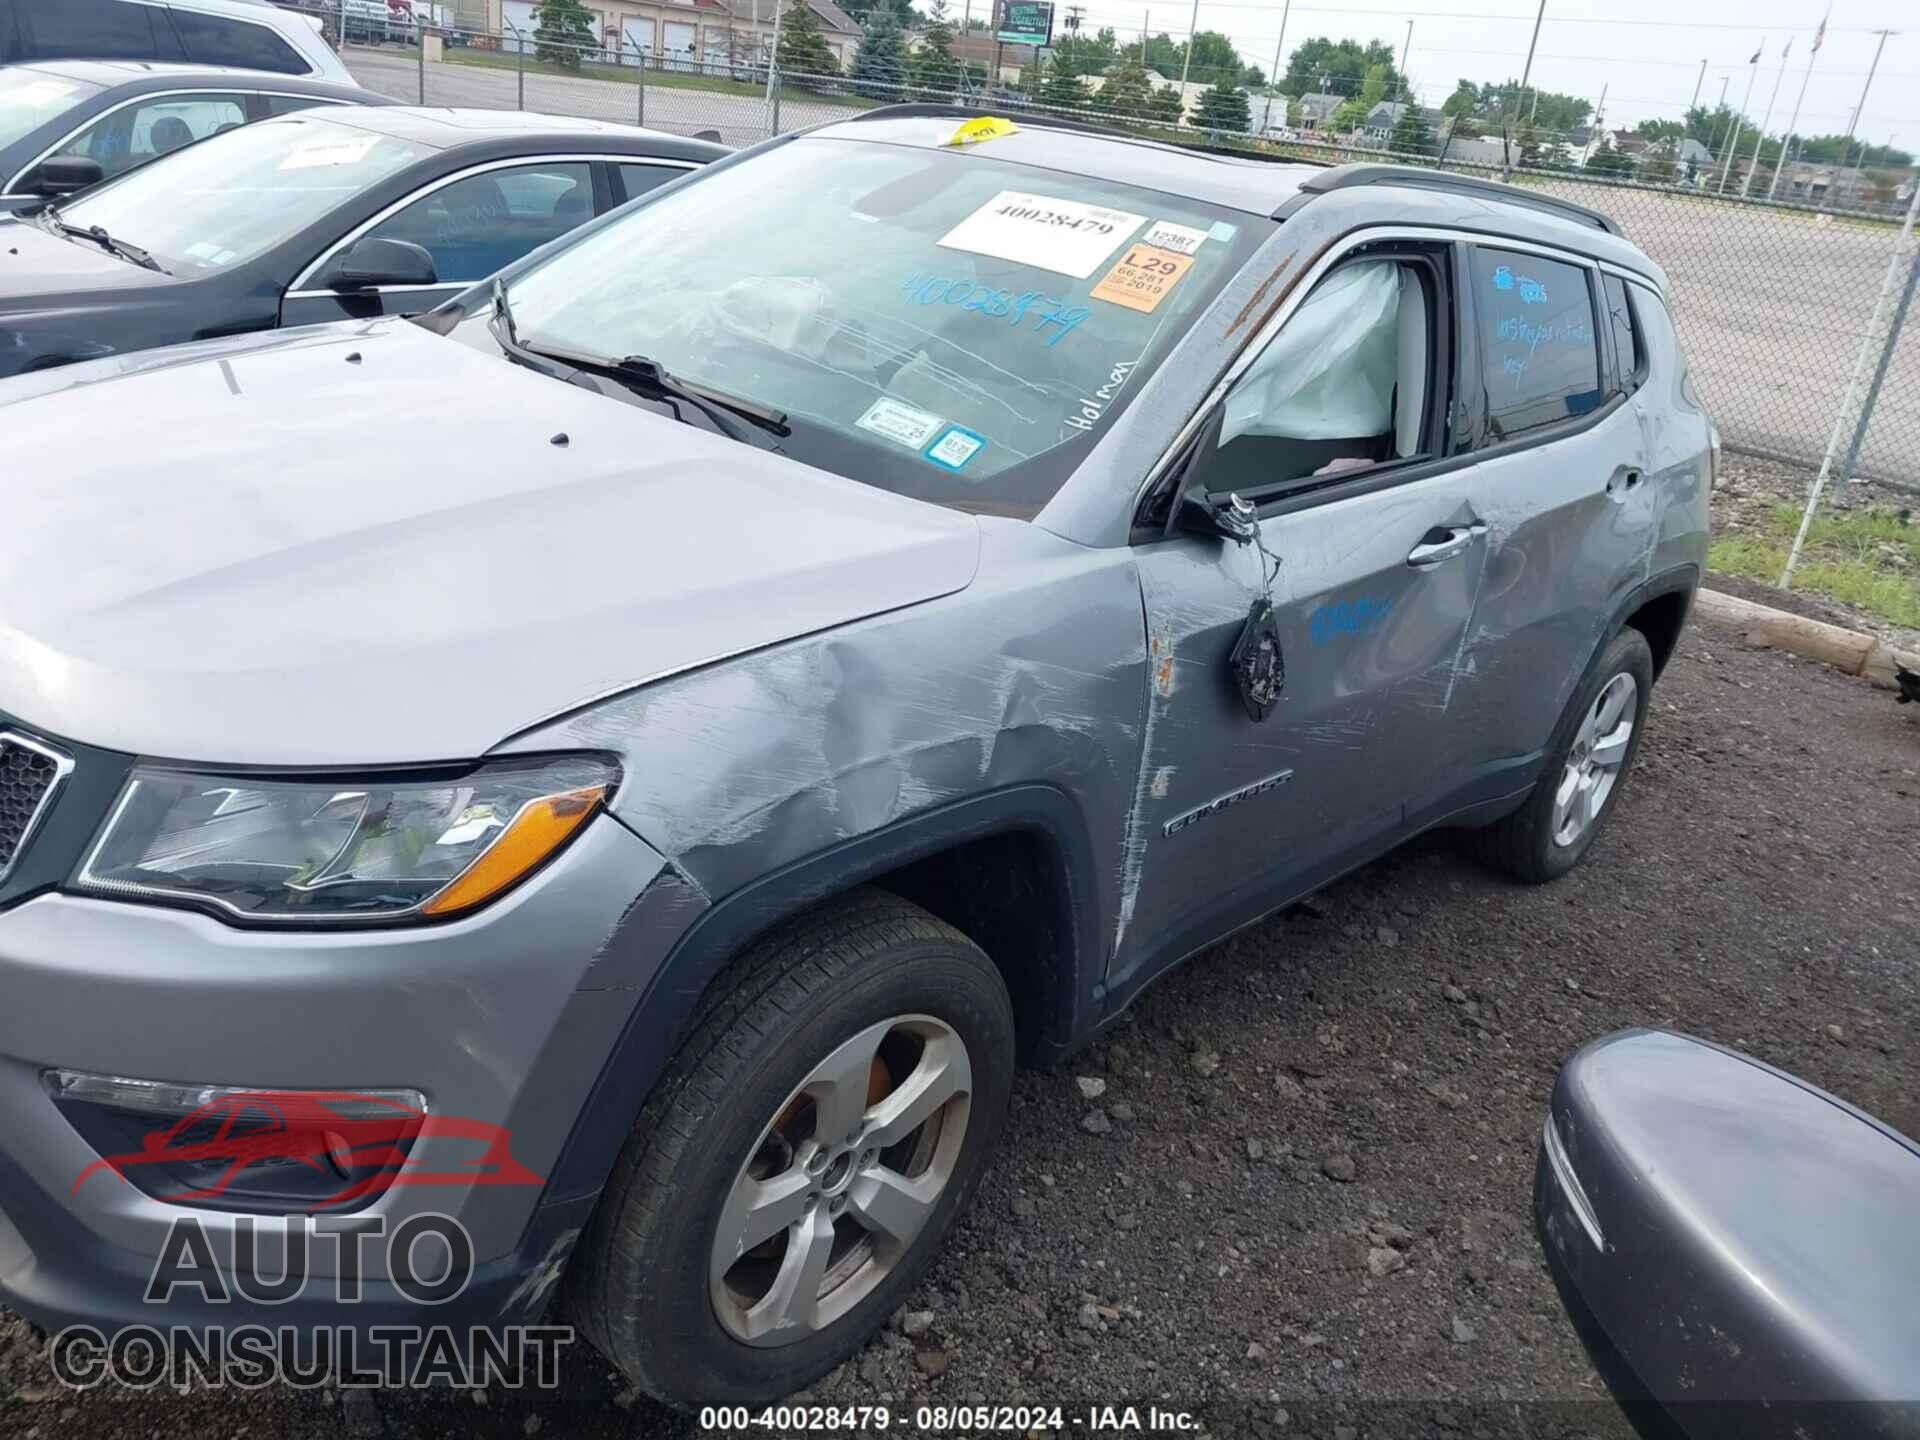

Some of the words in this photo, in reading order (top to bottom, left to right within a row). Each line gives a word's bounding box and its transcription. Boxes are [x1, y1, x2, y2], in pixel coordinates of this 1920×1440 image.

[996, 205, 1115, 235] 40028479
[1152, 230, 1197, 247] 12387
[1126, 281, 1162, 295] 2019
[902, 271, 1093, 349] 40028479
